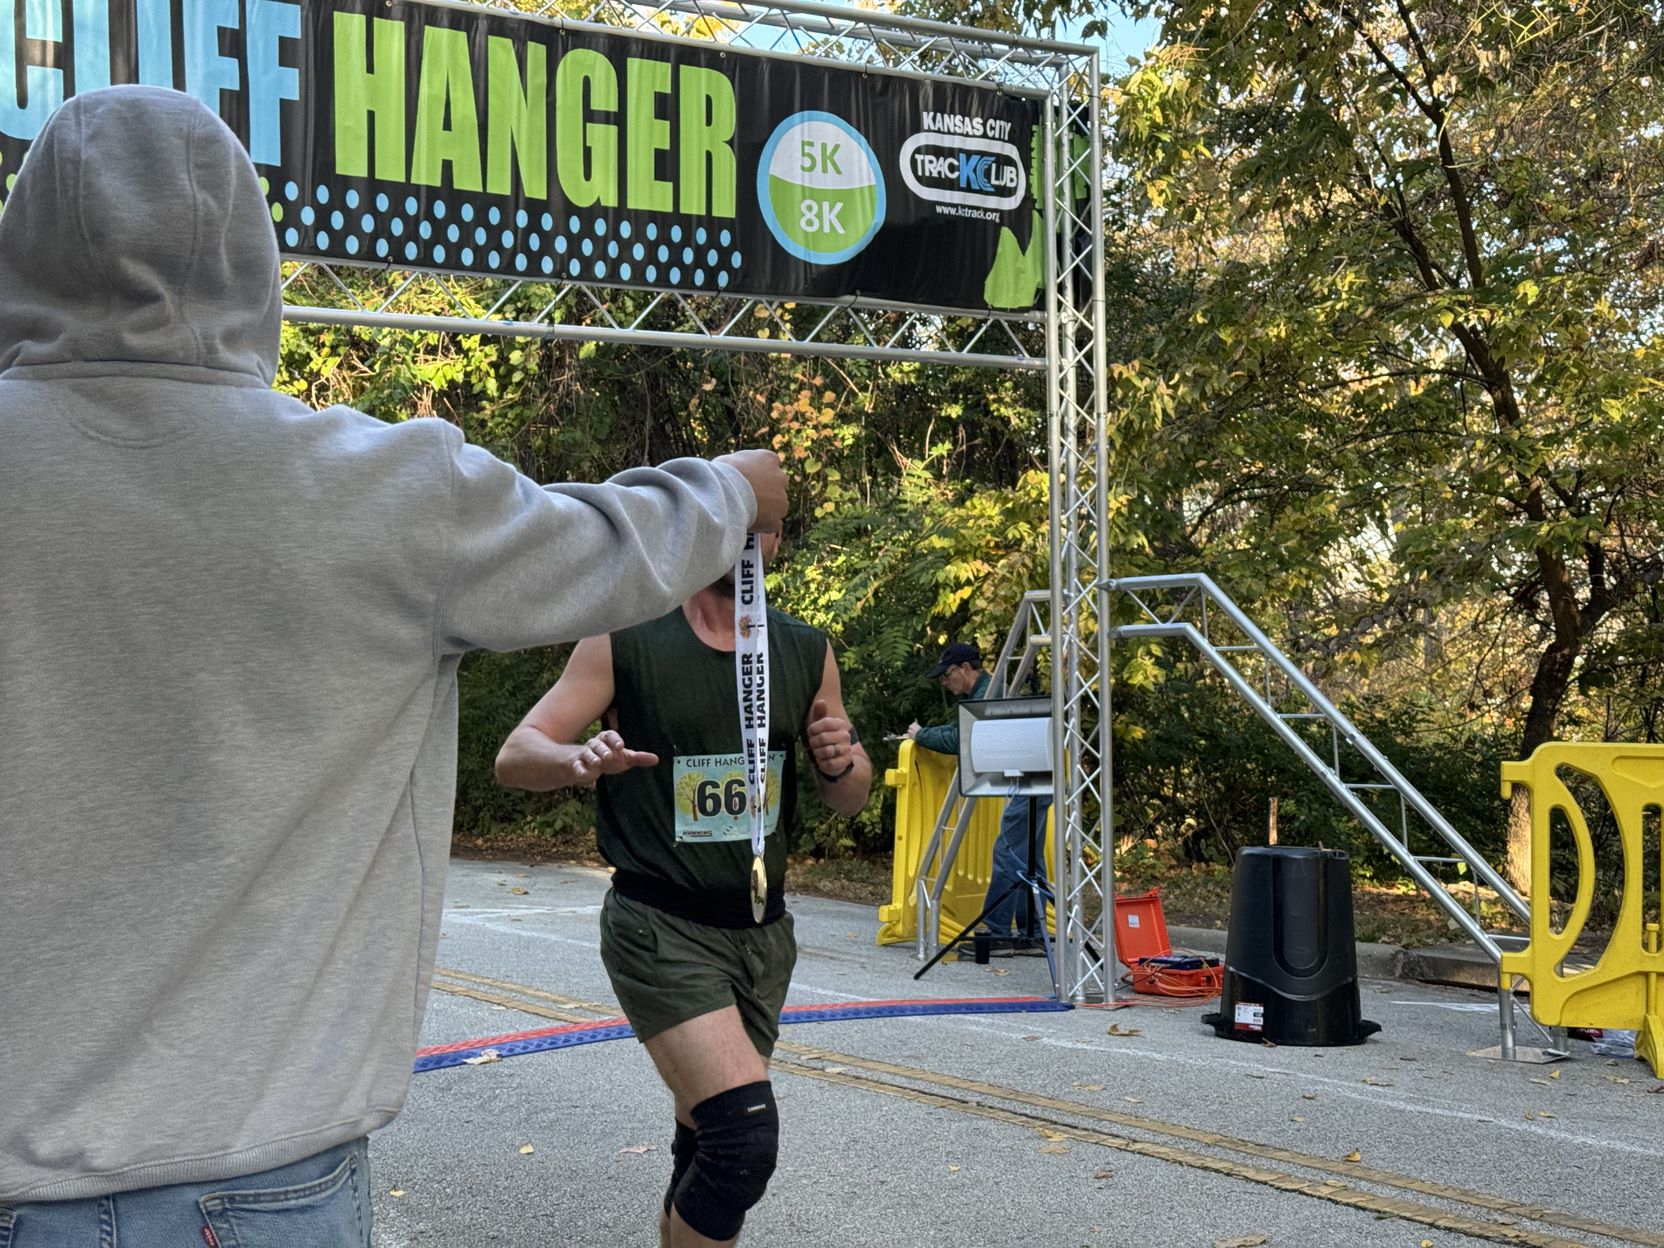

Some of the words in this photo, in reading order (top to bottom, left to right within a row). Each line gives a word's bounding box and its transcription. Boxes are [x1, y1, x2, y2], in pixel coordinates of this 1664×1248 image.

[333, 11, 737, 218] HANGER
[922, 111, 984, 136] KANSAS
[986, 118, 1012, 140] CITY
[800, 139, 843, 175] 5K
[799, 199, 846, 234] 8K
[935, 204, 1001, 223] www.kctrack.org
[741, 559, 754, 606] CLIFF
[741, 652, 754, 729] HANGER
[756, 652, 766, 729] HANGER
[686, 758, 711, 768] CLIFF
[714, 756, 745, 767] HANG
[746, 738, 756, 785] CLIFF
